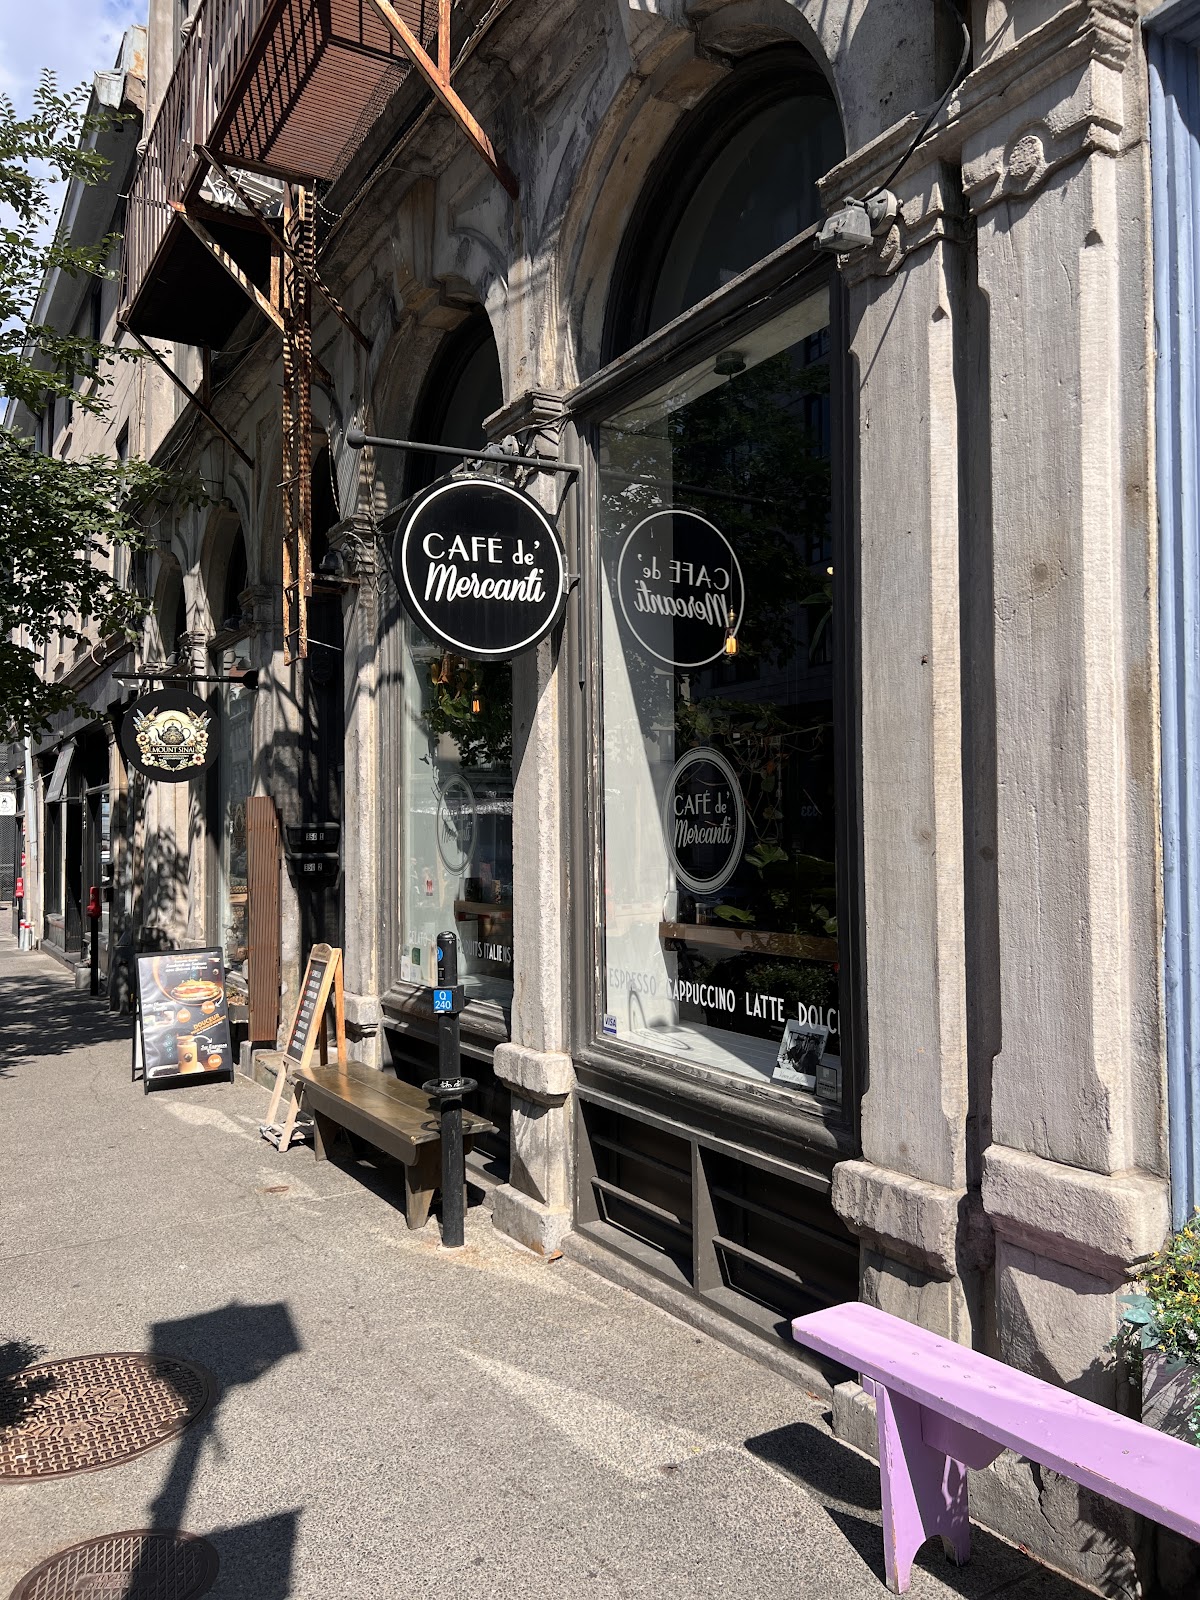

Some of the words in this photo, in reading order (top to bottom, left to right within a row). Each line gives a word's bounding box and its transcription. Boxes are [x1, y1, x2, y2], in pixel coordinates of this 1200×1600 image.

[424, 562, 545, 602] Mercanti
[673, 790, 711, 816] CAFÉ
[673, 816, 731, 848] Mercanti
[483, 942, 512, 964] ITALIENS
[435, 1001, 452, 1010] 240
[439, 991, 447, 1001] Q
[609, 968, 657, 996] ESPRESSO
[666, 977, 735, 1013] CAPPUCCINO
[745, 991, 785, 1023] LATTE
[193, 1013, 220, 1030] DOUCEUR
[604, 1016, 617, 1028] VISA
